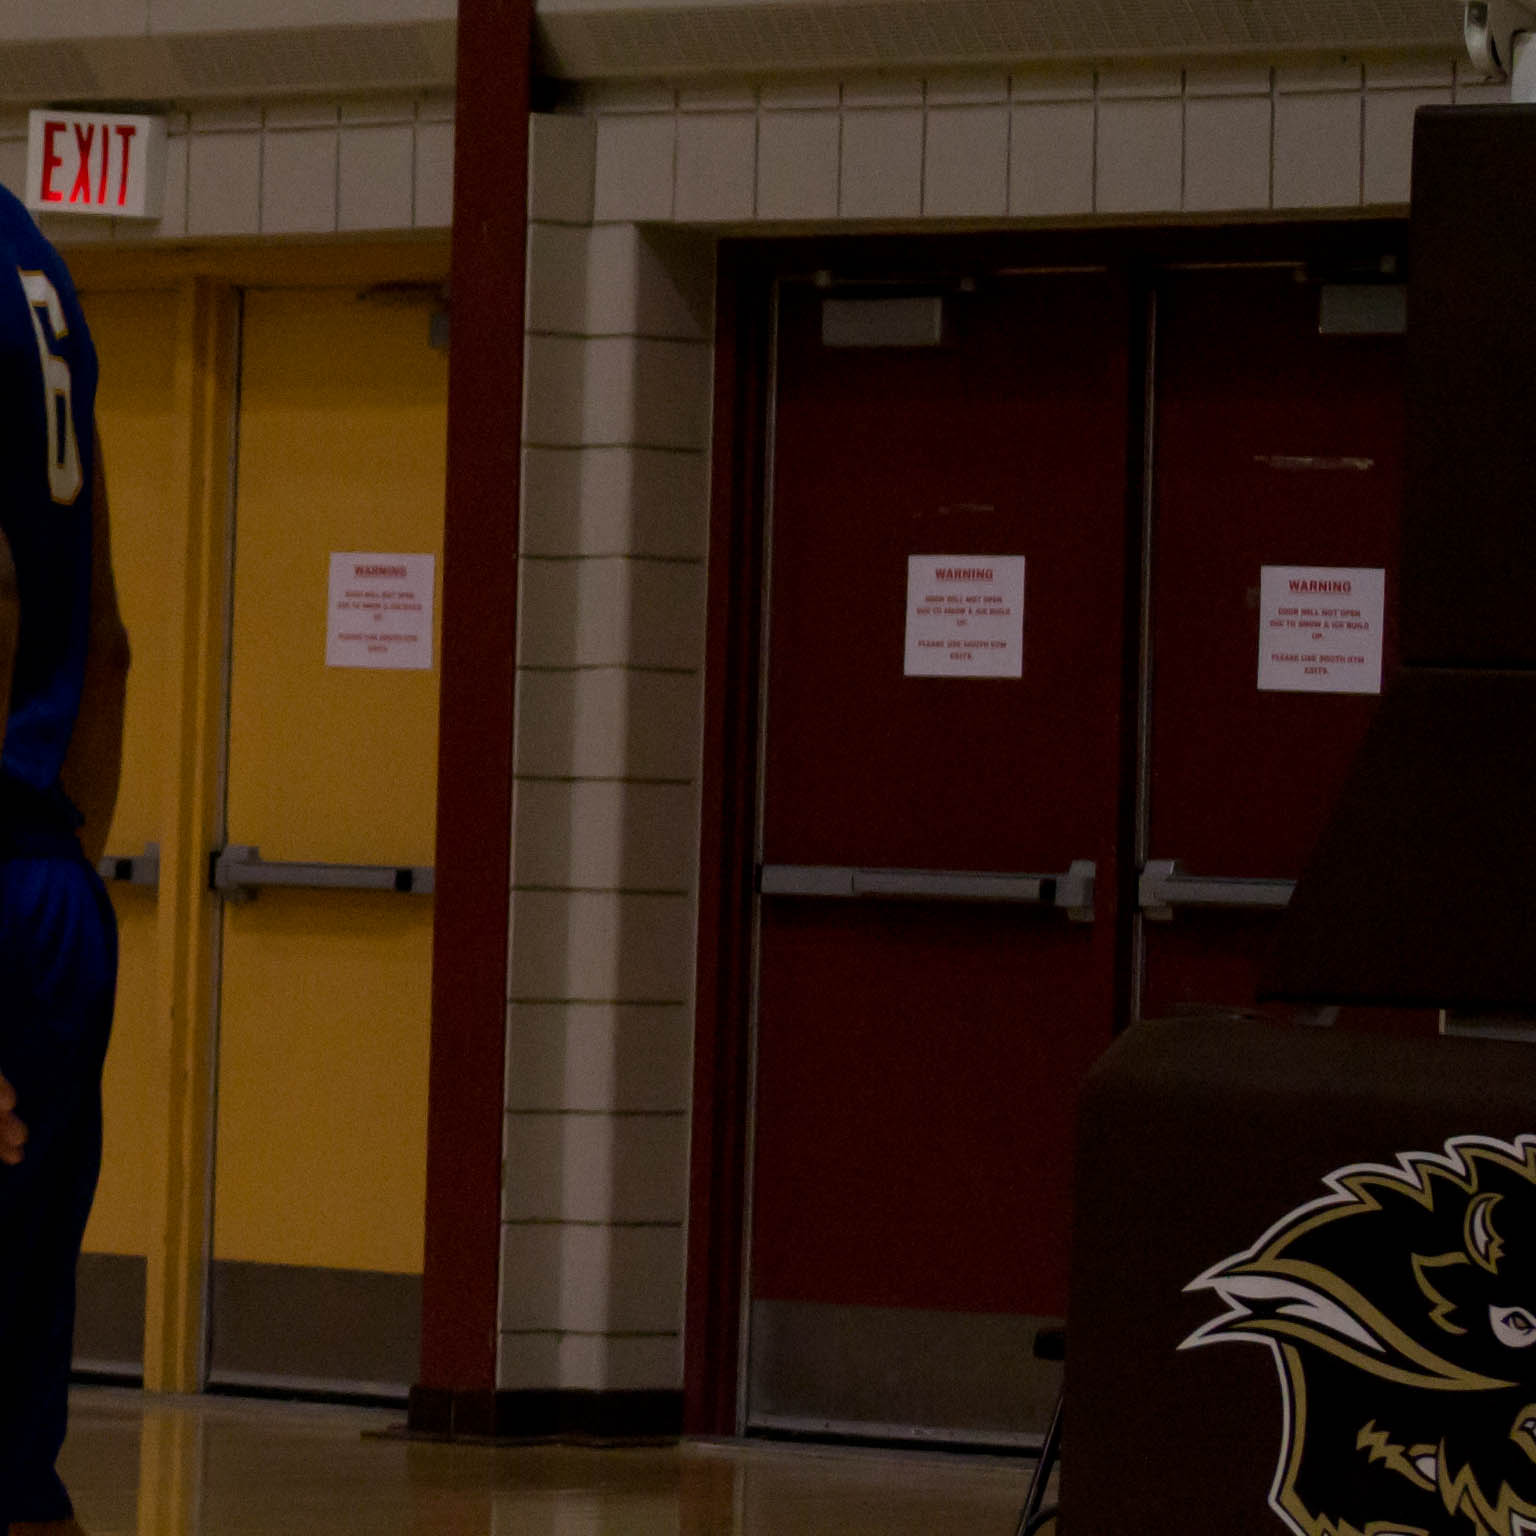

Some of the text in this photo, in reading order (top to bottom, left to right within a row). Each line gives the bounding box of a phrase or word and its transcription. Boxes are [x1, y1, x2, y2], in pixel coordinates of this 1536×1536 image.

[41, 121, 137, 206] EXIT
[16, 267, 84, 507] 6
[935, 567, 994, 580] WARNING
[1288, 579, 1352, 593] WARNING
